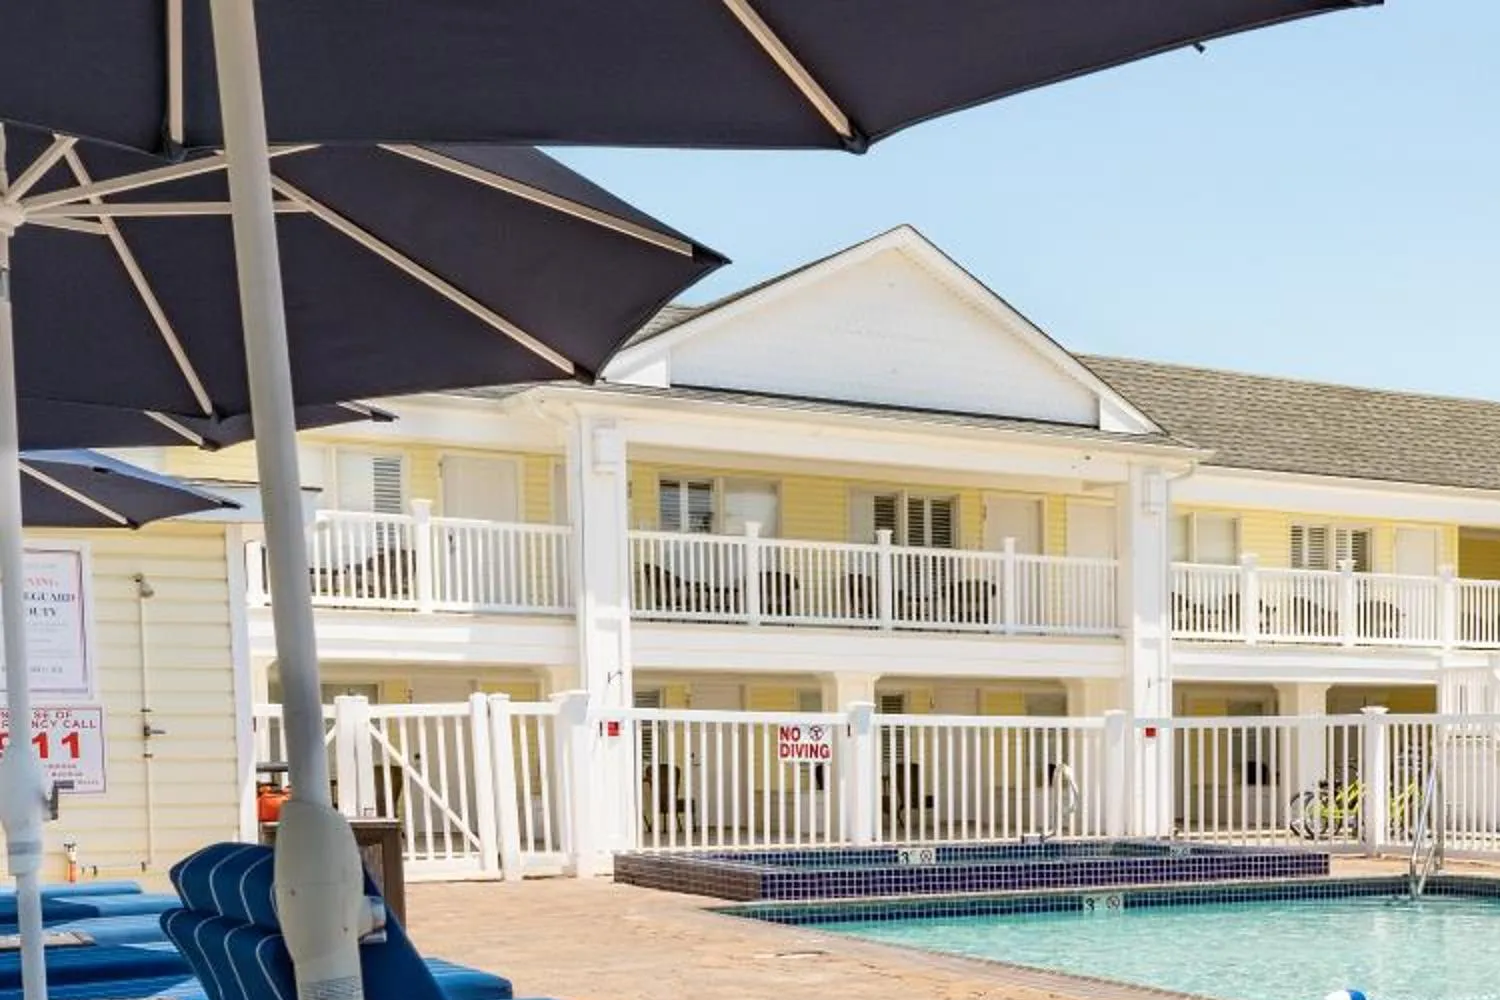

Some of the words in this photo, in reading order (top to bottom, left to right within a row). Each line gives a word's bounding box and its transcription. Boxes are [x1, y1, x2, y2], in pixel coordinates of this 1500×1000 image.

[56, 711, 72, 719] OF
[63, 719, 96, 729] CALL
[780, 726, 801, 742] NO
[780, 743, 830, 759] DIVING
